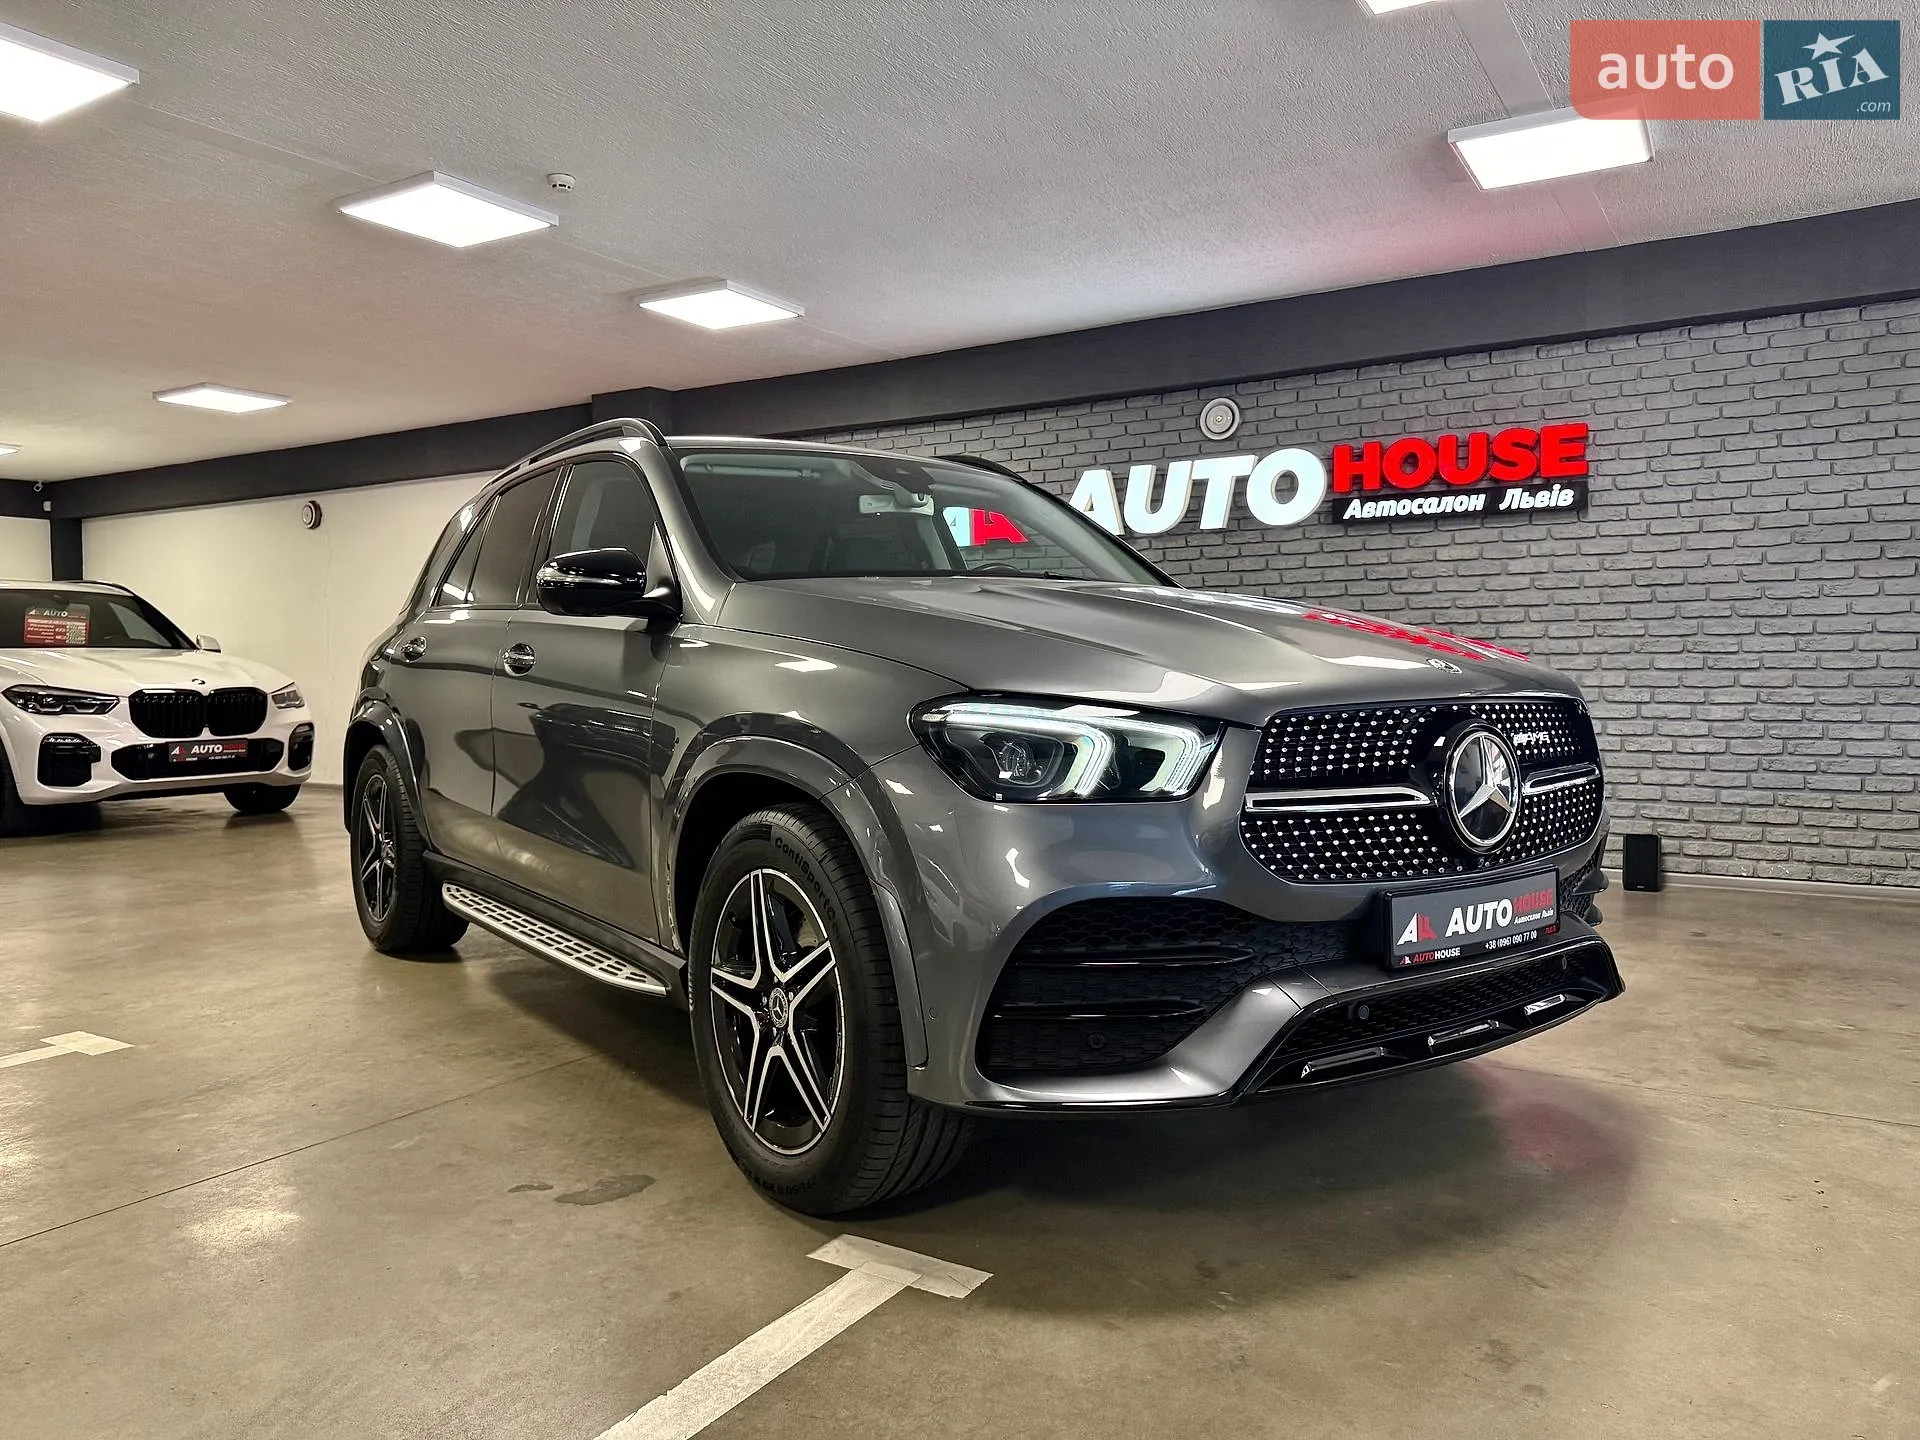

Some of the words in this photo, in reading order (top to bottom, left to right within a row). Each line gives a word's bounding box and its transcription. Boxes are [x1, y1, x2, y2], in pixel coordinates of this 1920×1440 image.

[1068, 447, 1327, 536] AUTO
[1332, 423, 1589, 493] HOUSE
[1342, 493, 1487, 521] Автосалон
[1499, 486, 1575, 512] Львів
[43, 609, 69, 618] AUTO
[191, 744, 223, 755] AUTO
[1445, 898, 1513, 937] AUTO
[1513, 887, 1553, 914] HOUSE
